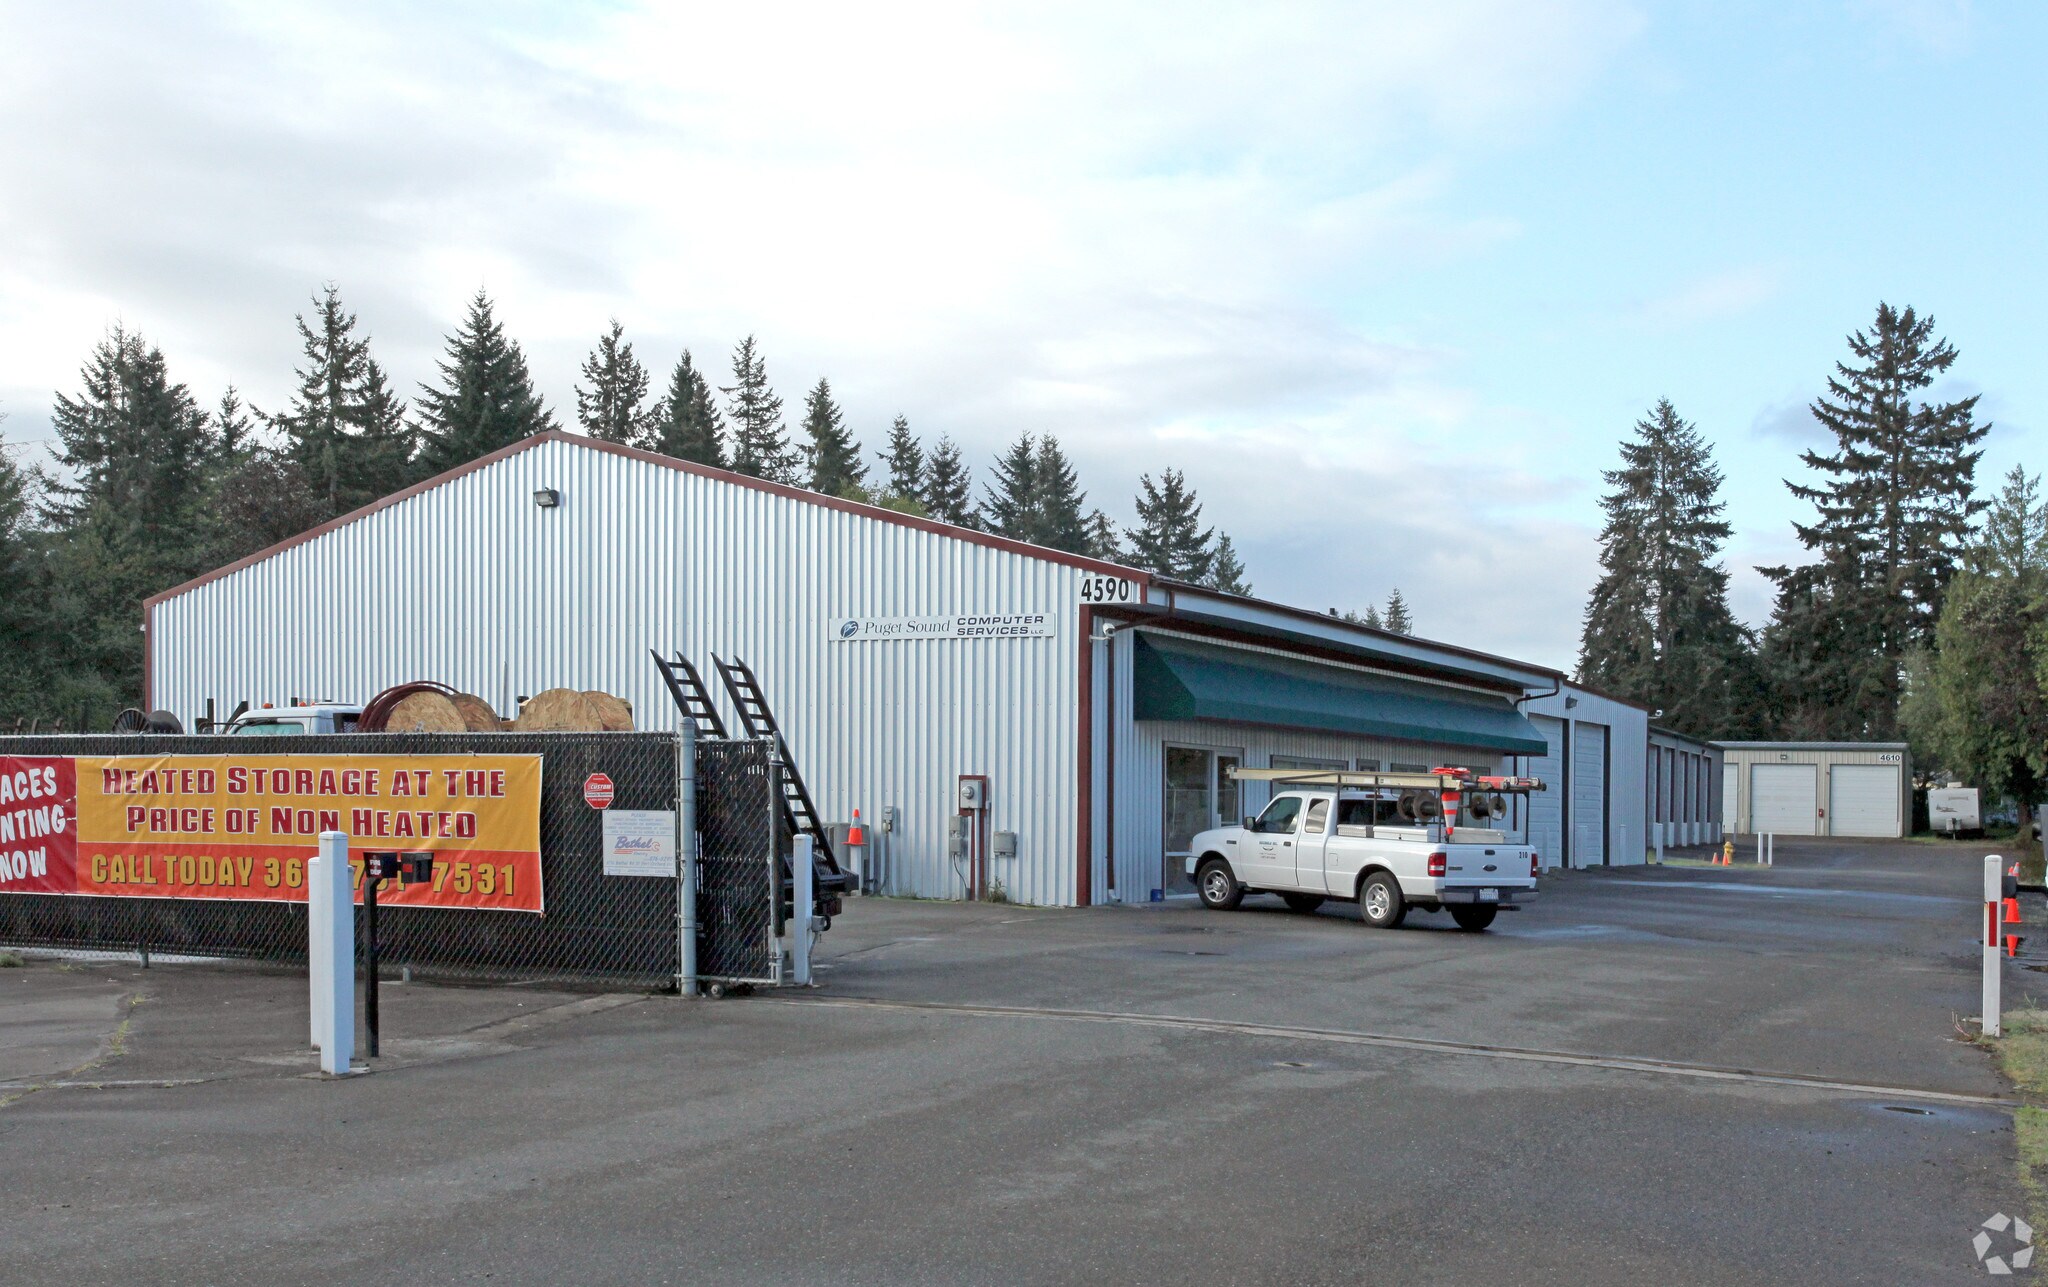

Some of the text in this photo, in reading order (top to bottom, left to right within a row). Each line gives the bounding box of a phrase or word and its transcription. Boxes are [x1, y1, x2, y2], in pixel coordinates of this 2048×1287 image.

[1081, 578, 1129, 602] 4590
[864, 619, 950, 636] Puget Sound
[957, 615, 1044, 626] COMPUTER
[957, 626, 1028, 636] SERVICES
[1880, 754, 1900, 762] 4610
[0, 766, 57, 805] ACES
[102, 766, 505, 798] HEATED STORAGE AT THE
[0, 804, 66, 844] NTING
[126, 805, 477, 840] PRICE OF NON HEATED
[615, 836, 652, 849] Bethel
[0, 846, 47, 883] NOW
[1519, 851, 1528, 859] 210
[91, 853, 158, 885] CALL
[163, 855, 254, 887] TODAY
[432, 862, 514, 896] 7531
